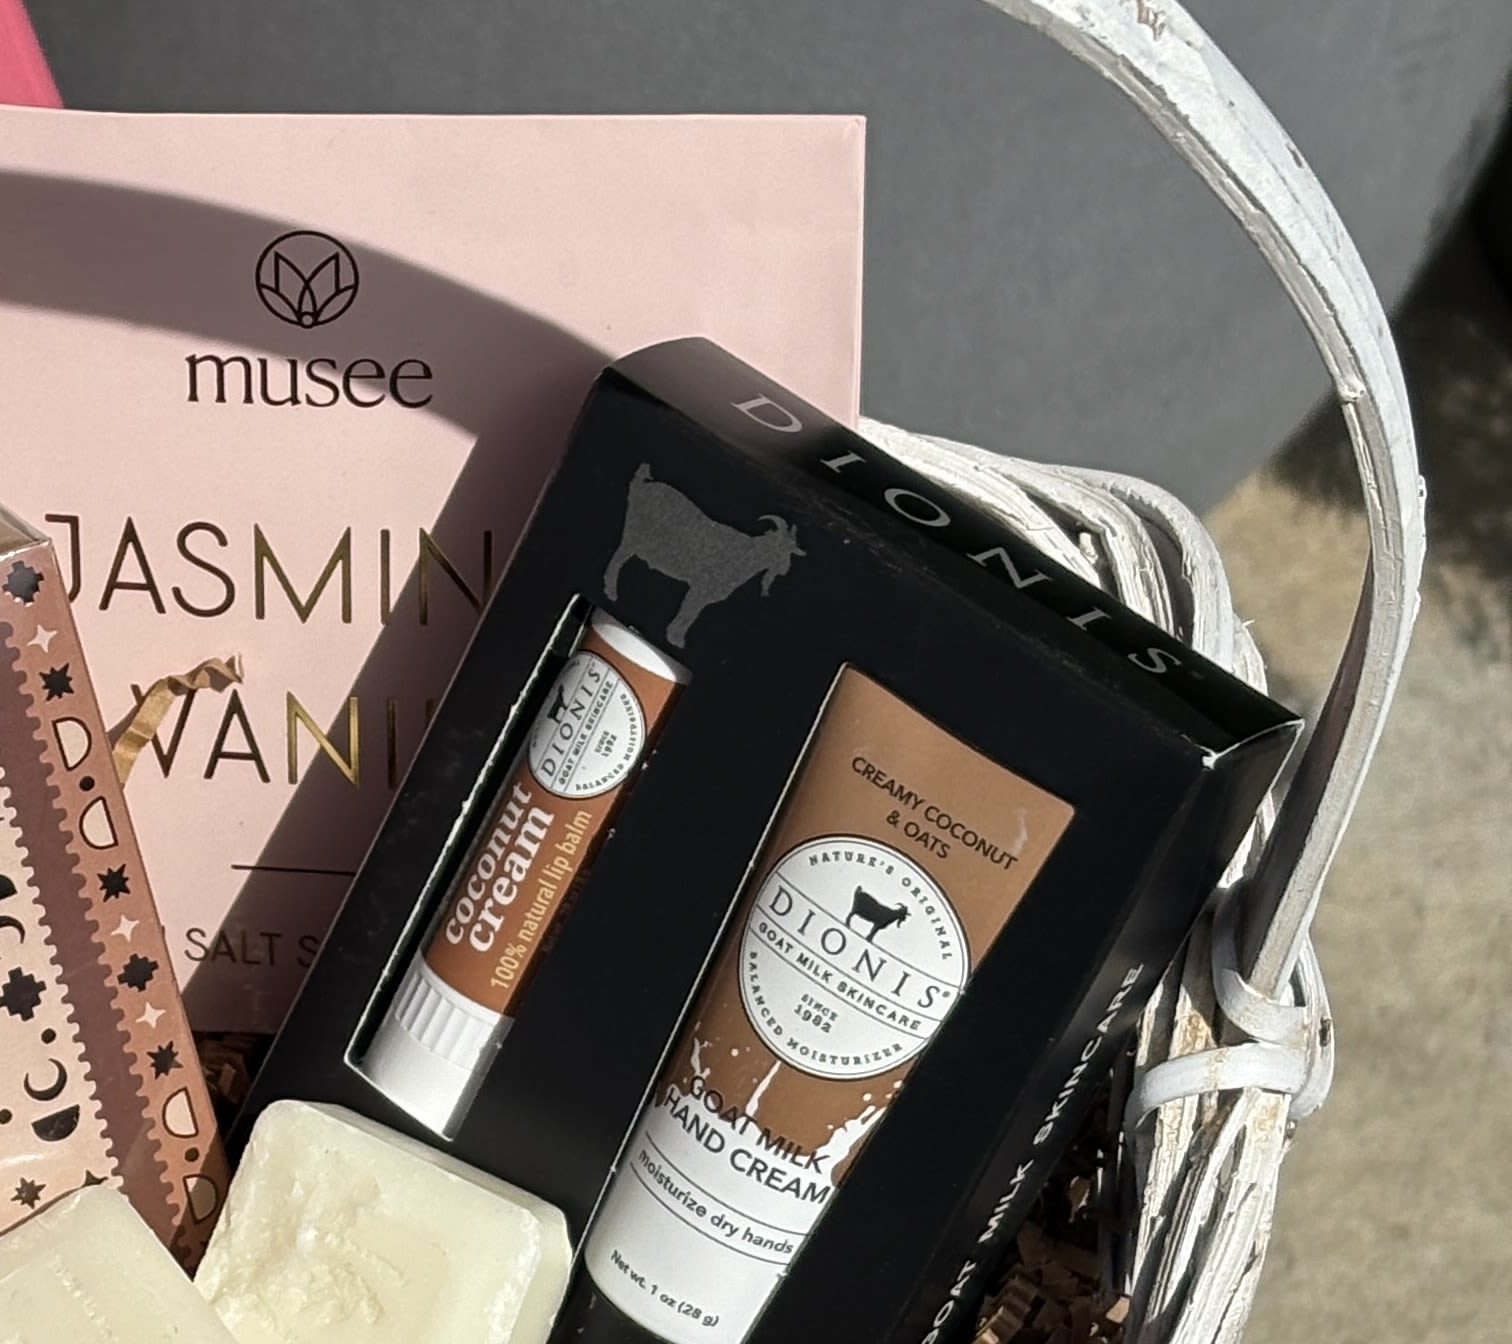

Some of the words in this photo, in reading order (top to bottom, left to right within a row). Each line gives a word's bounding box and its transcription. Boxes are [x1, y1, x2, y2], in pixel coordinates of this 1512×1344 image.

[186, 351, 433, 409] musee
[45, 513, 493, 625] JASMIN
[731, 394, 1182, 674] DIONIS
[131, 684, 435, 789] VANI
[445, 781, 532, 945] coconut
[555, 810, 593, 856] balm
[851, 756, 926, 811] CREAMY
[924, 804, 1020, 871] COCONUT
[885, 809, 899, 828] &
[903, 821, 951, 860] OATS
[469, 806, 554, 952] cream
[519, 877, 558, 943] natural
[542, 855, 573, 881] lip
[184, 927, 282, 967] SALT
[491, 942, 527, 989] 100%
[901, 877, 953, 960] ORIGINAL
[748, 951, 784, 1036] BALANCED
[787, 1037, 903, 1066] MOISTURIZER
[759, 921, 794, 954] GOAT
[796, 952, 833, 984] MILK
[837, 981, 921, 1031] SKINCARE
[793, 1004, 832, 1034] 1982
[801, 993, 839, 1022] SINCE
[663, 1087, 726, 1154] HAND
[729, 1148, 832, 1205] CREAM
[690, 1075, 757, 1136] GOAT
[759, 1128, 831, 1175] MILK
[978, 1159, 1035, 1243] MILK
[1033, 963, 1144, 1145] SKINCARE
[638, 1149, 707, 1218] moisturize
[710, 1211, 740, 1238] dry
[742, 1227, 794, 1256] hands
[610, 1249, 630, 1274] Net
[630, 1271, 647, 1290] wt.
[660, 1292, 676, 1308] oz
[678, 1299, 701, 1320] (28
[702, 1313, 720, 1328] g)
